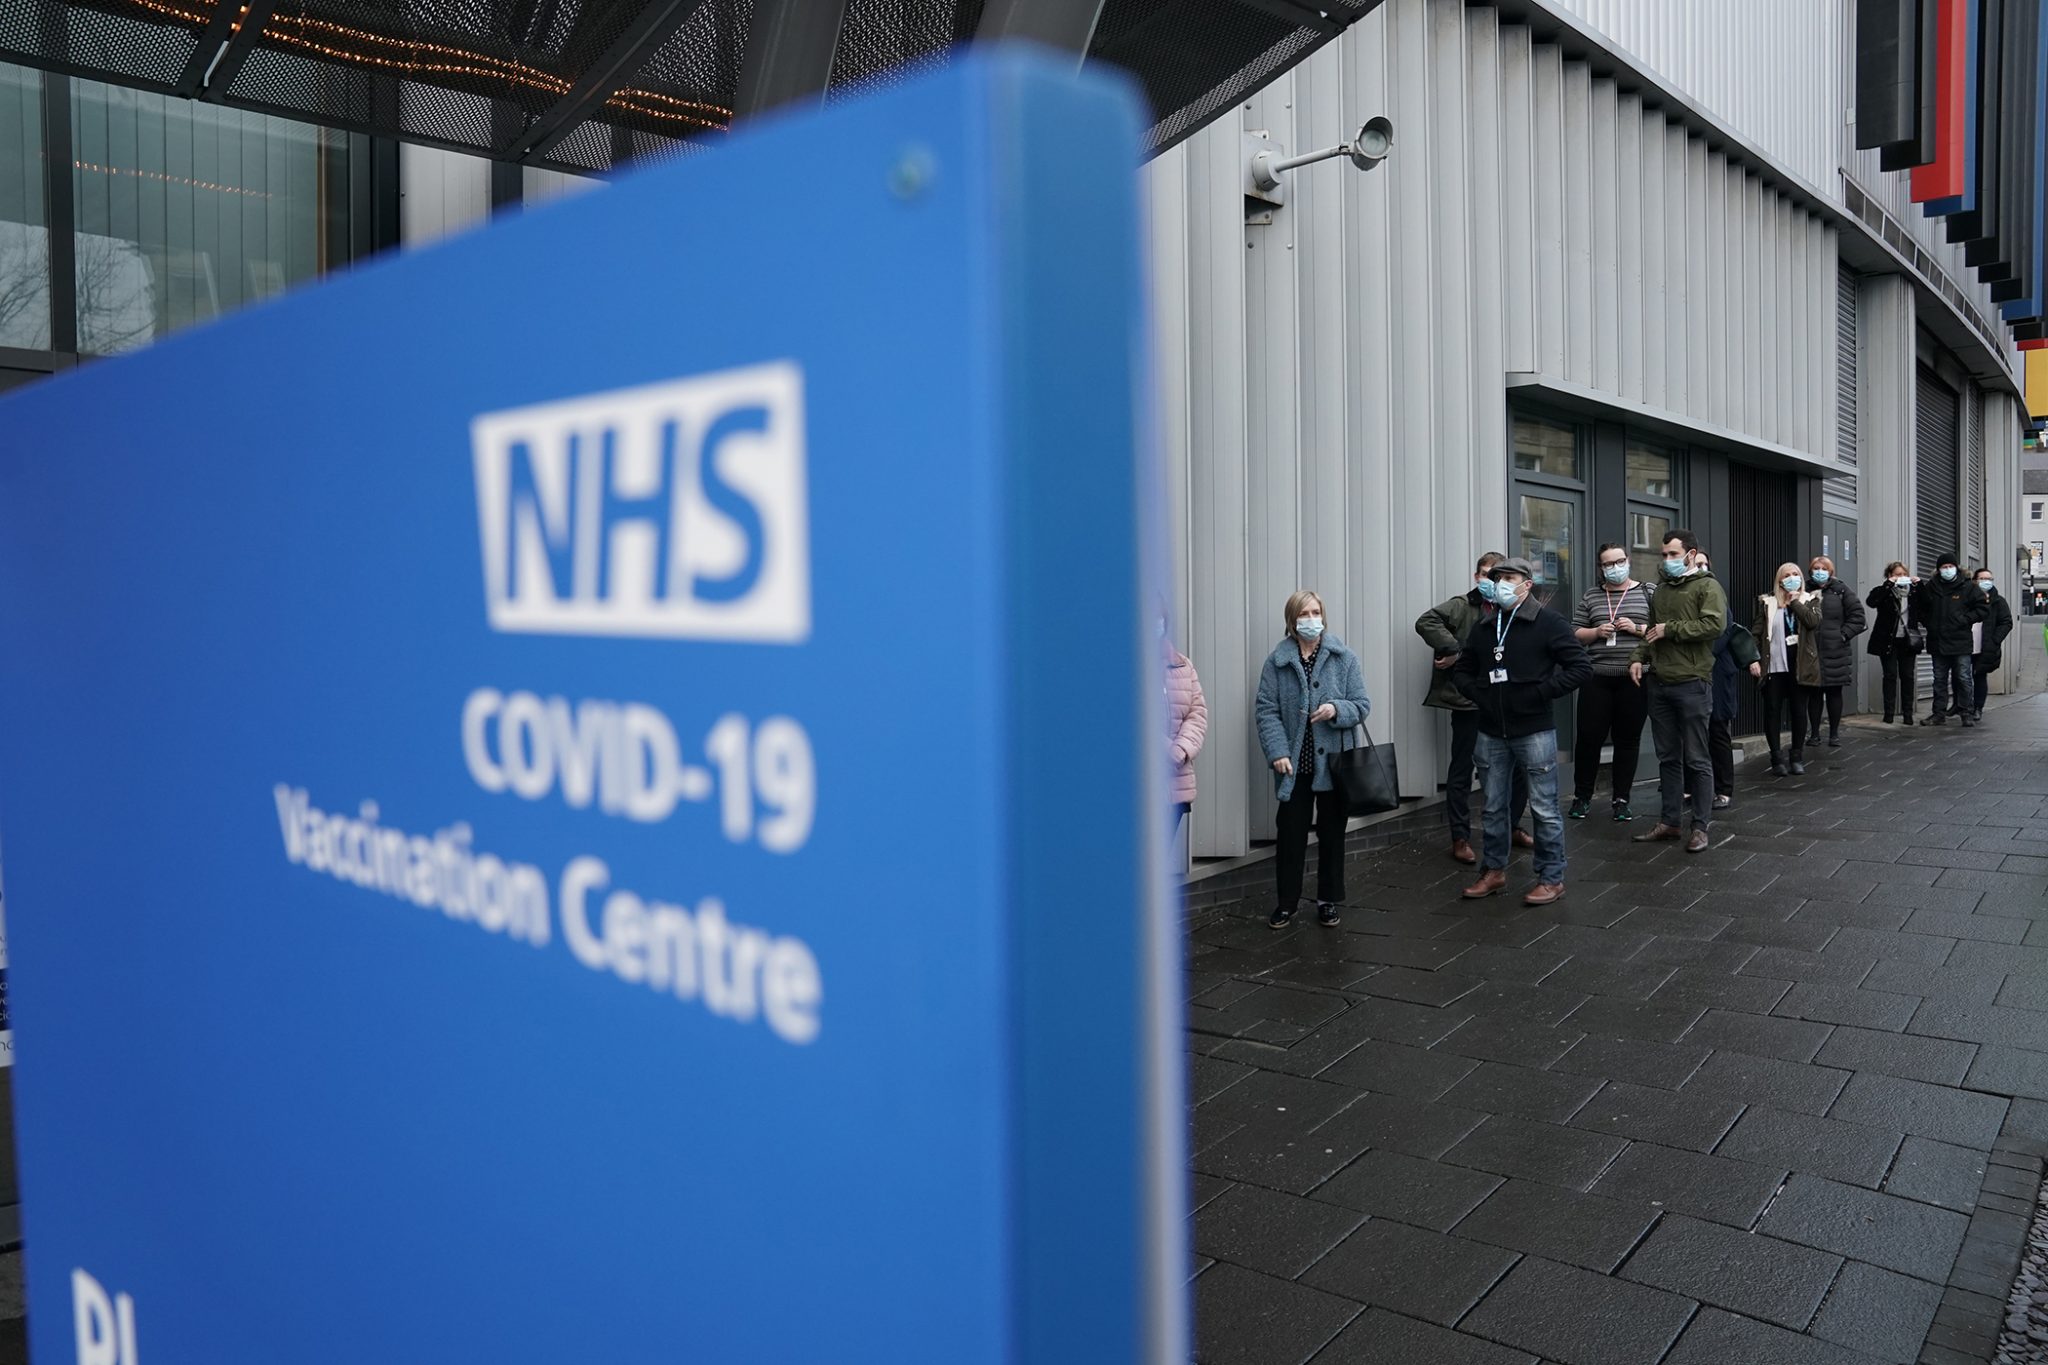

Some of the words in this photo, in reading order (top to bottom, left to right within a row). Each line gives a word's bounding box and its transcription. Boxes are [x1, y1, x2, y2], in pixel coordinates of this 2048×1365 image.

[504, 397, 772, 609] NHS
[462, 687, 815, 854] COVID-19
[274, 783, 551, 948] Vaccination
[560, 854, 823, 1044] Centre
